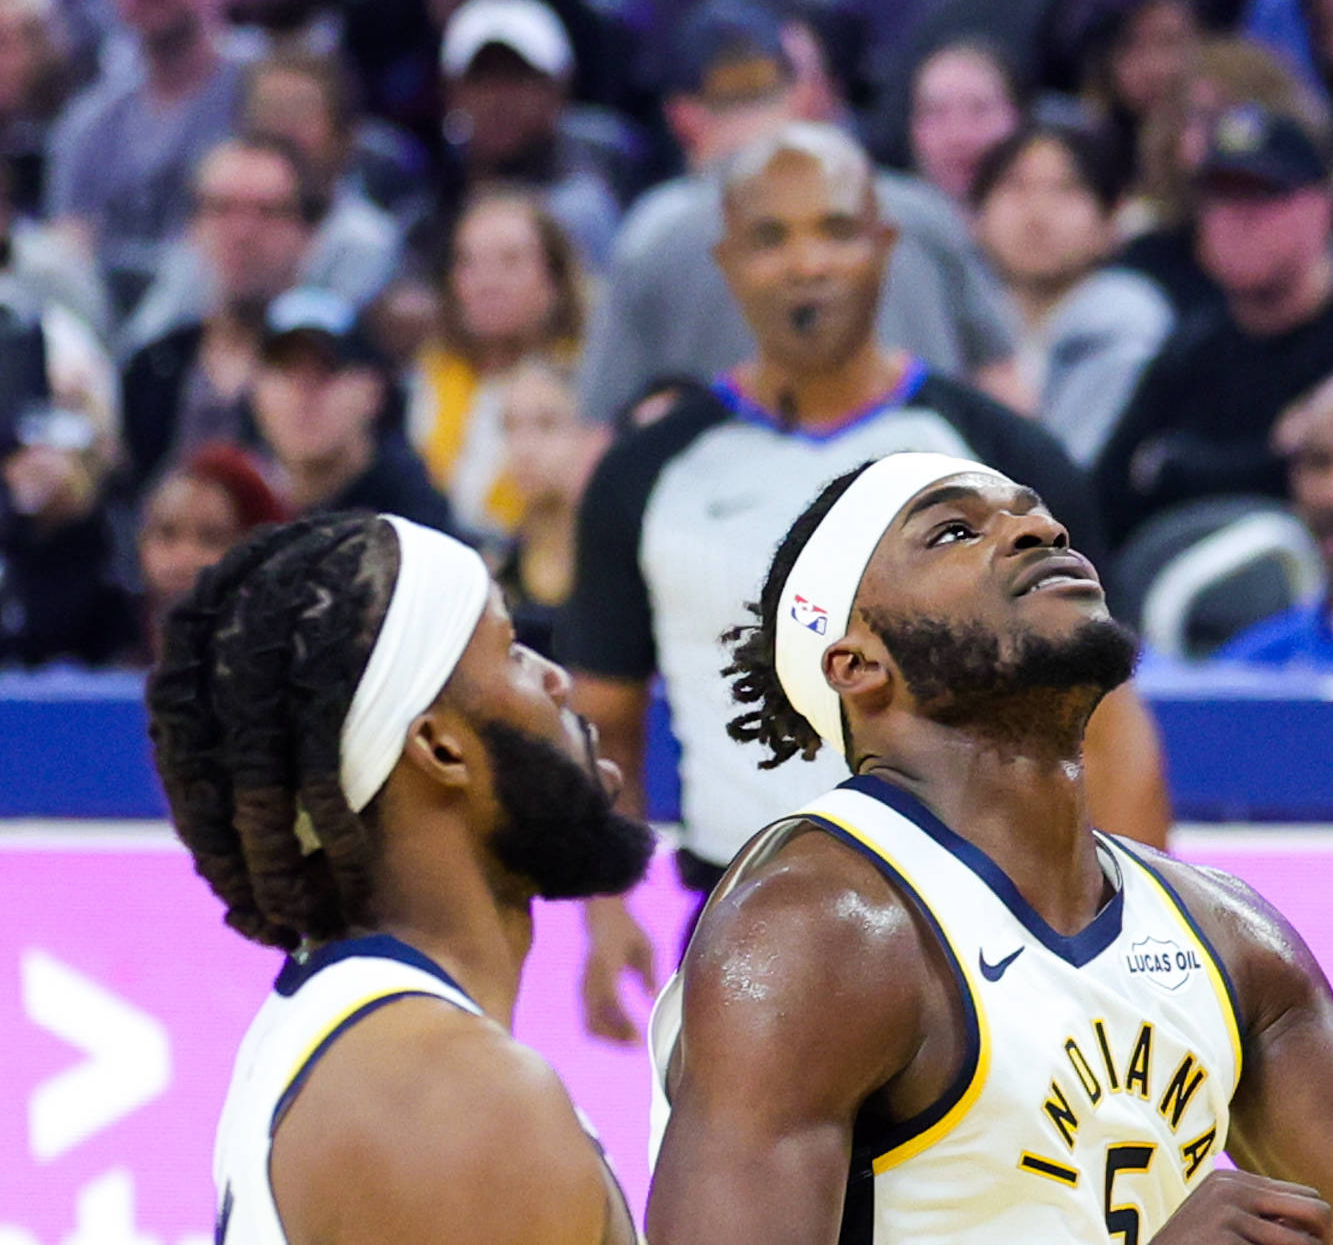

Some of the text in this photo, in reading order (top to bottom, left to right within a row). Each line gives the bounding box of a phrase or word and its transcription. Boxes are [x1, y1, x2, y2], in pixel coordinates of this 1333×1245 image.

[1126, 950, 1202, 974] LUCAS OIL
[1018, 1018, 1217, 1187] INDIANA
[1104, 1140, 1159, 1245] 5
